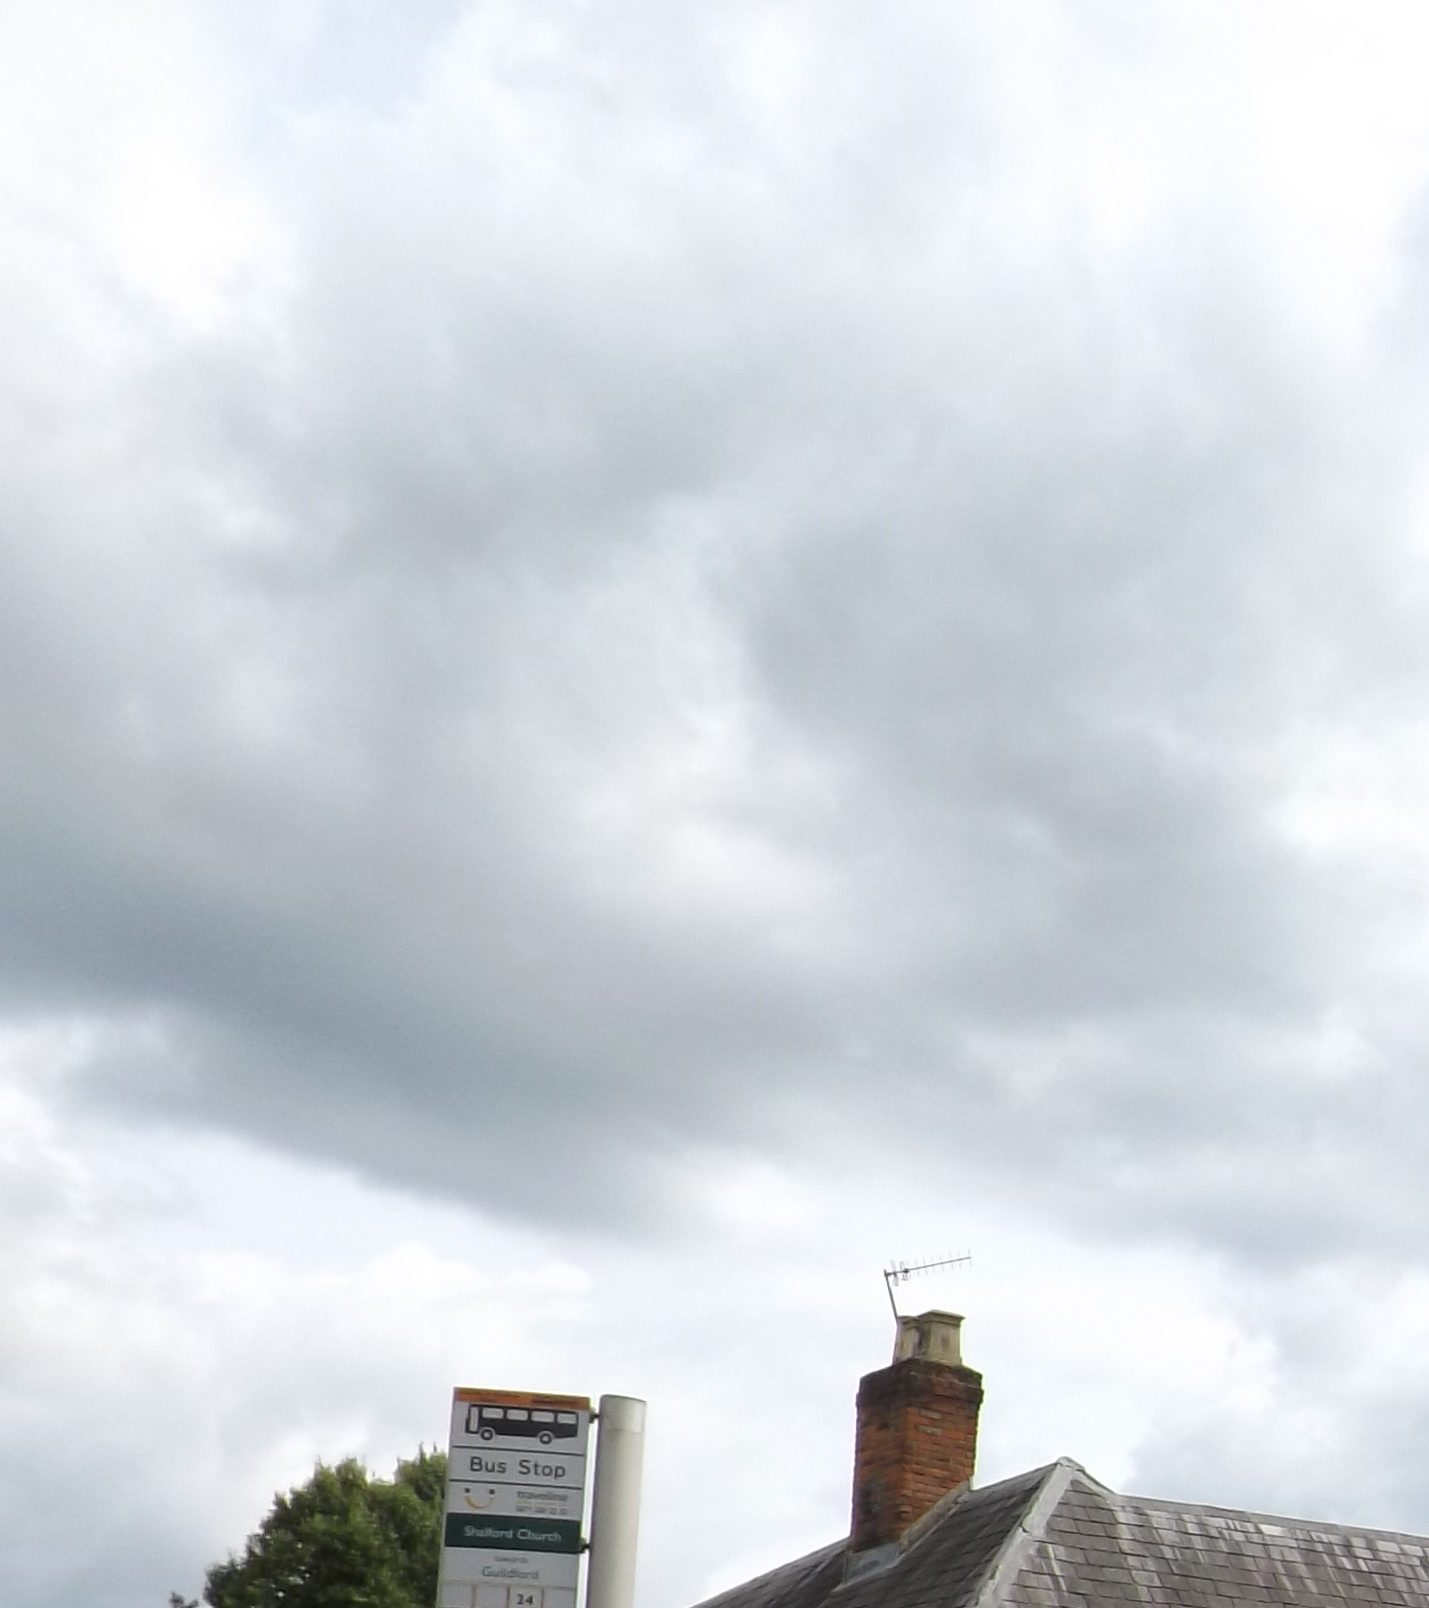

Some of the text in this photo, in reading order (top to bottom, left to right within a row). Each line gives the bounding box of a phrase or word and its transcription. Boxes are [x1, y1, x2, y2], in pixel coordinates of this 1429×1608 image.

[470, 1456, 566, 1480] Bus Stop
[464, 1524, 562, 1542] Shalford Church
[482, 1566, 539, 1579] Guildford
[517, 1594, 534, 1606] 24
